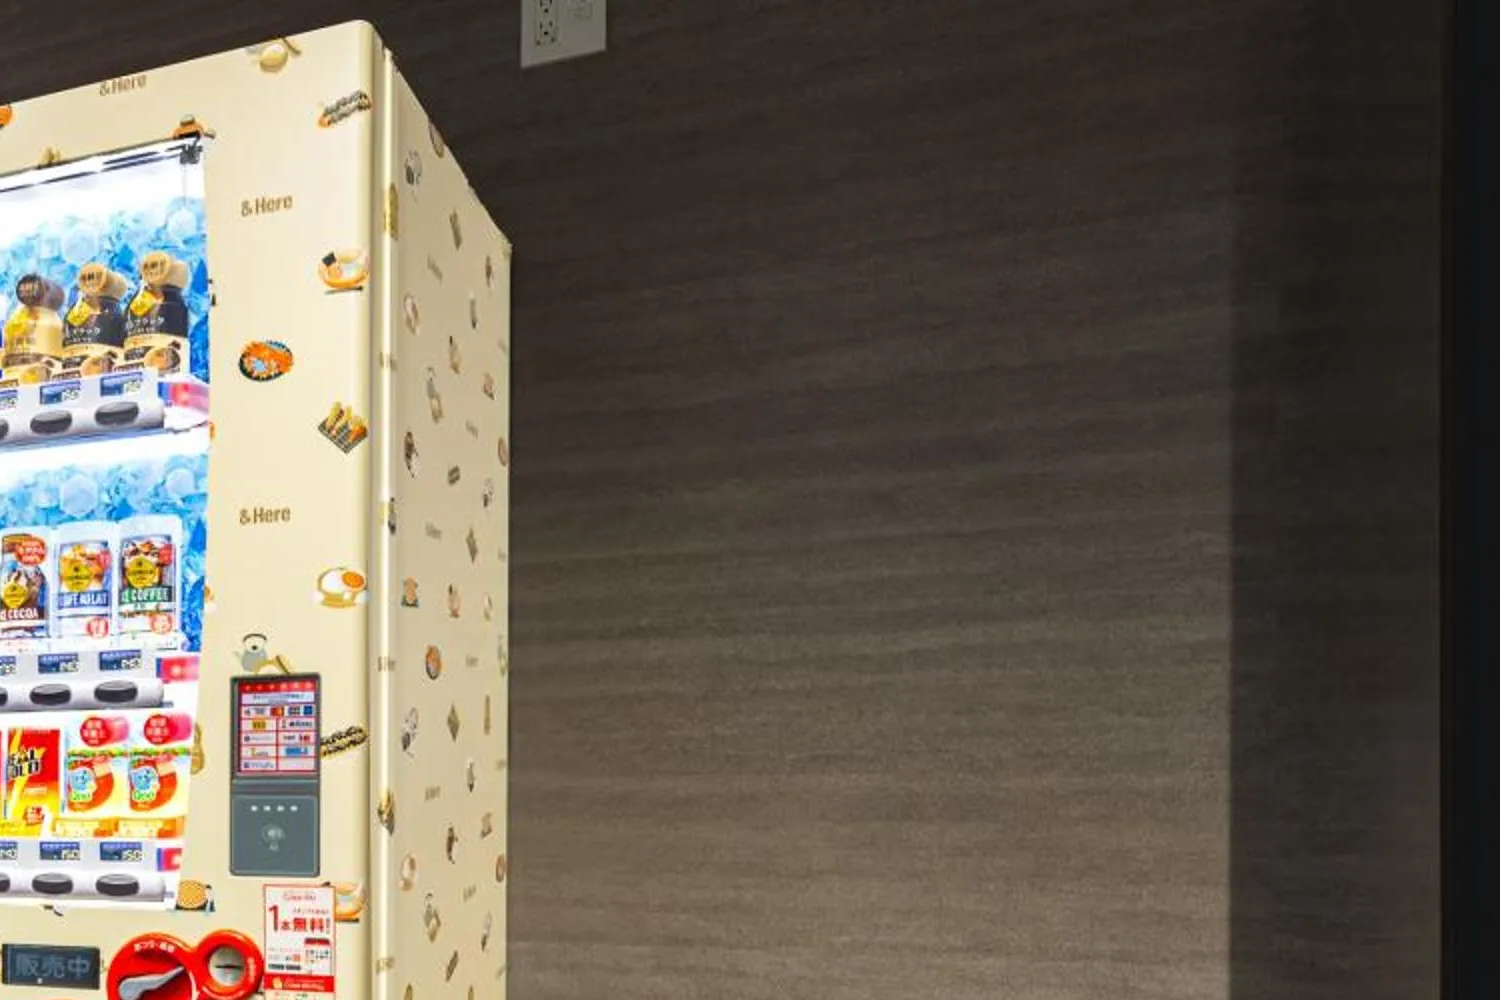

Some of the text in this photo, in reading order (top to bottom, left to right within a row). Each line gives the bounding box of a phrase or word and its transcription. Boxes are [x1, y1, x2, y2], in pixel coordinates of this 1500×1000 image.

[240, 194, 293, 217] &Here
[239, 506, 292, 525] &Here
[14, 953, 92, 979] 販売中
